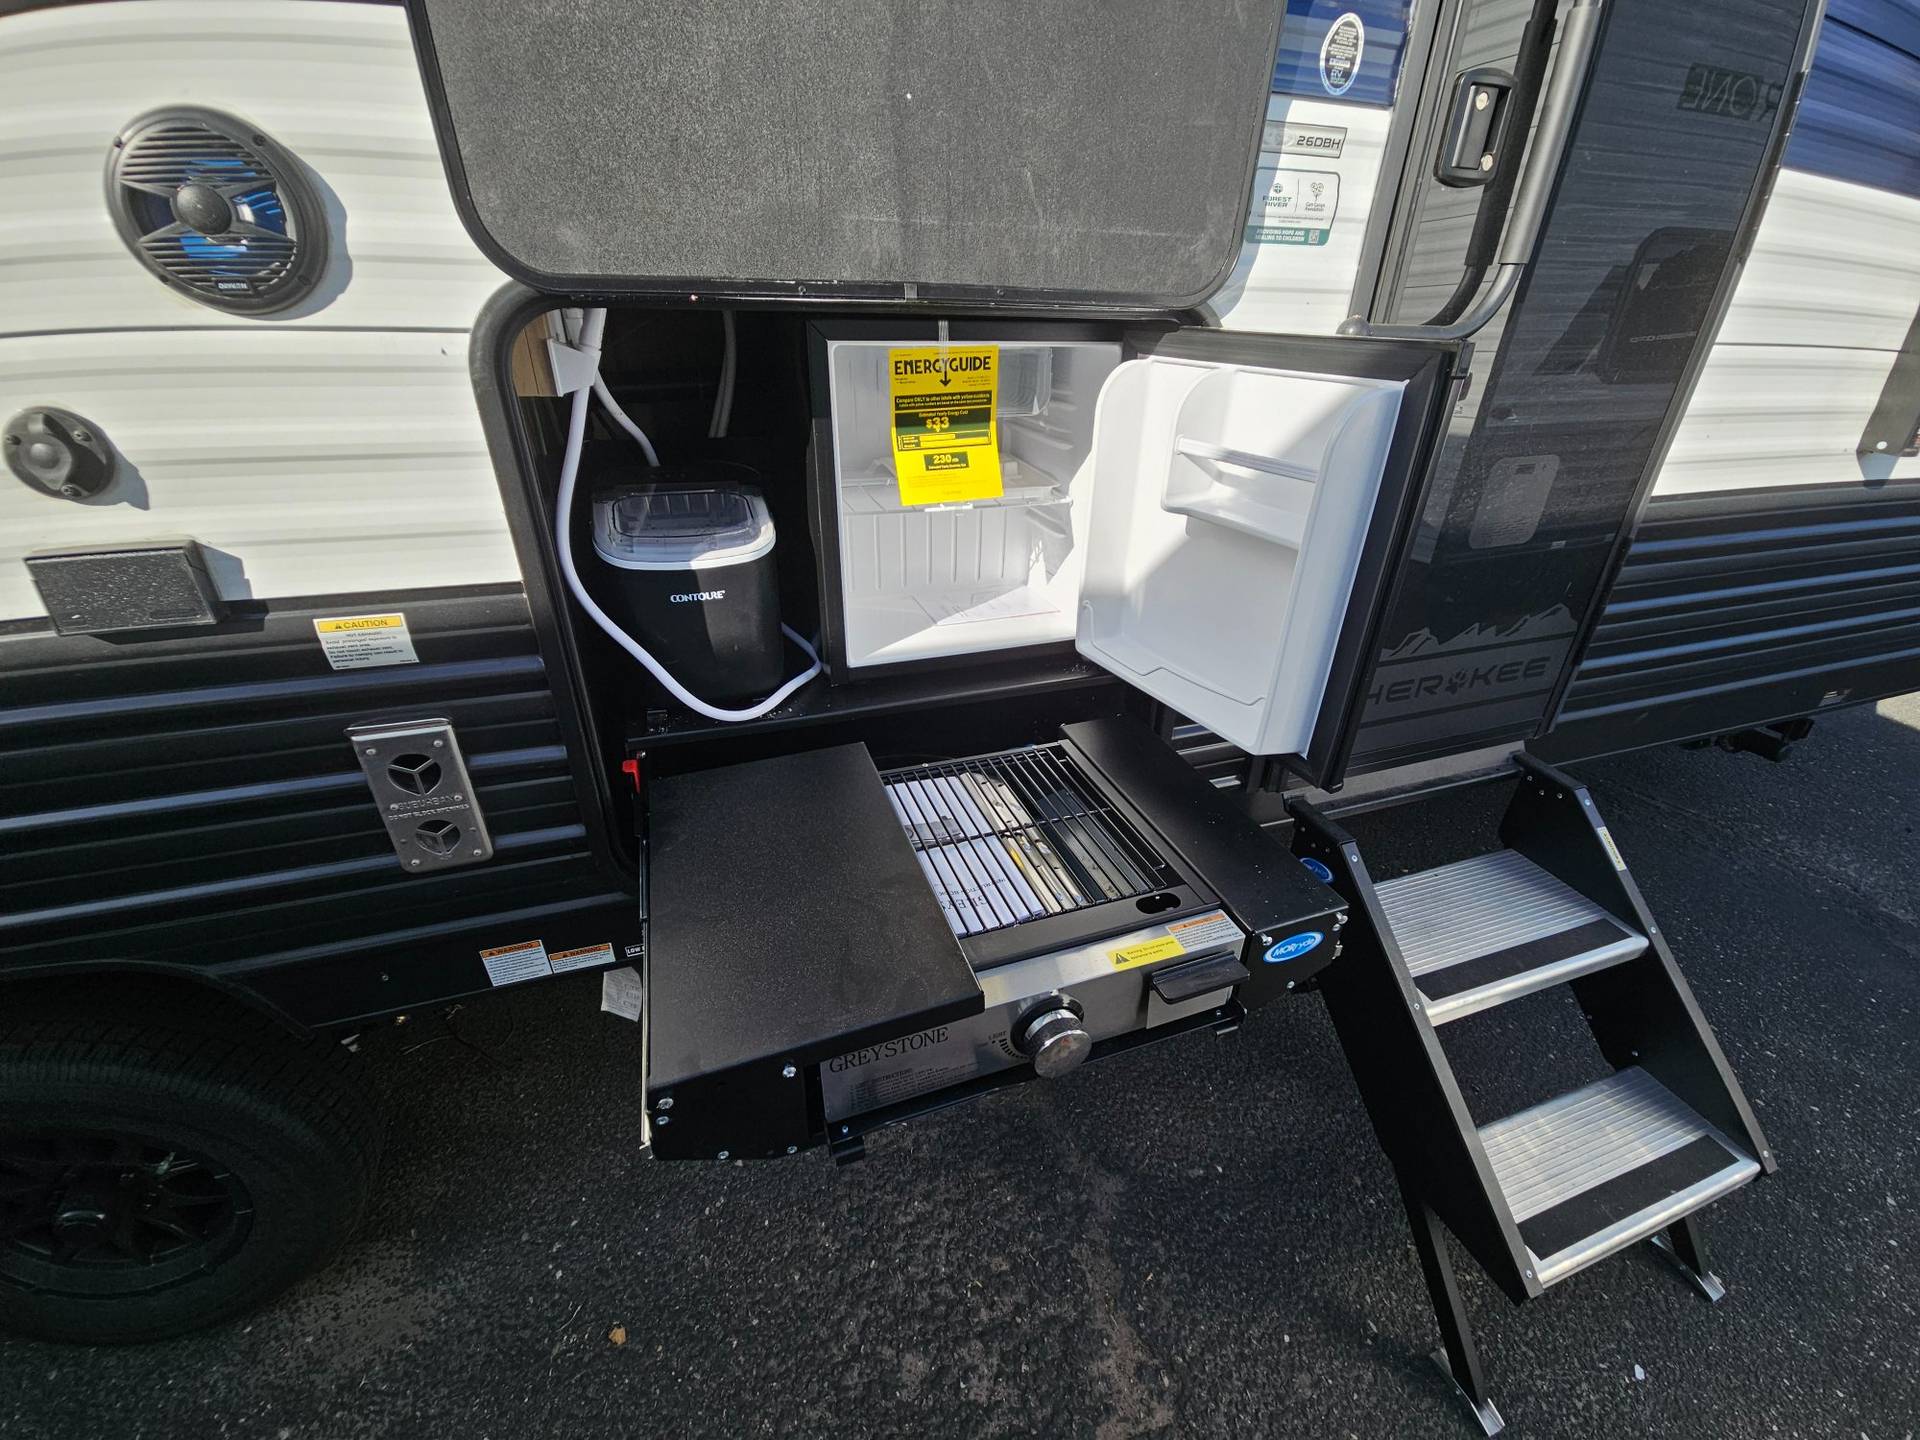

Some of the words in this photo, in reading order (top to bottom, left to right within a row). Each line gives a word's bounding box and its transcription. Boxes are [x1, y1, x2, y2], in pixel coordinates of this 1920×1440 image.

[1297, 135, 1342, 150] 26DBH
[926, 416, 950, 429] $33
[932, 455, 952, 464] 230
[343, 619, 388, 629] CAUTION
[398, 795, 453, 811] SUBURBAN
[627, 946, 641, 954] LOW
[829, 1026, 949, 1073] GREYSTONE
